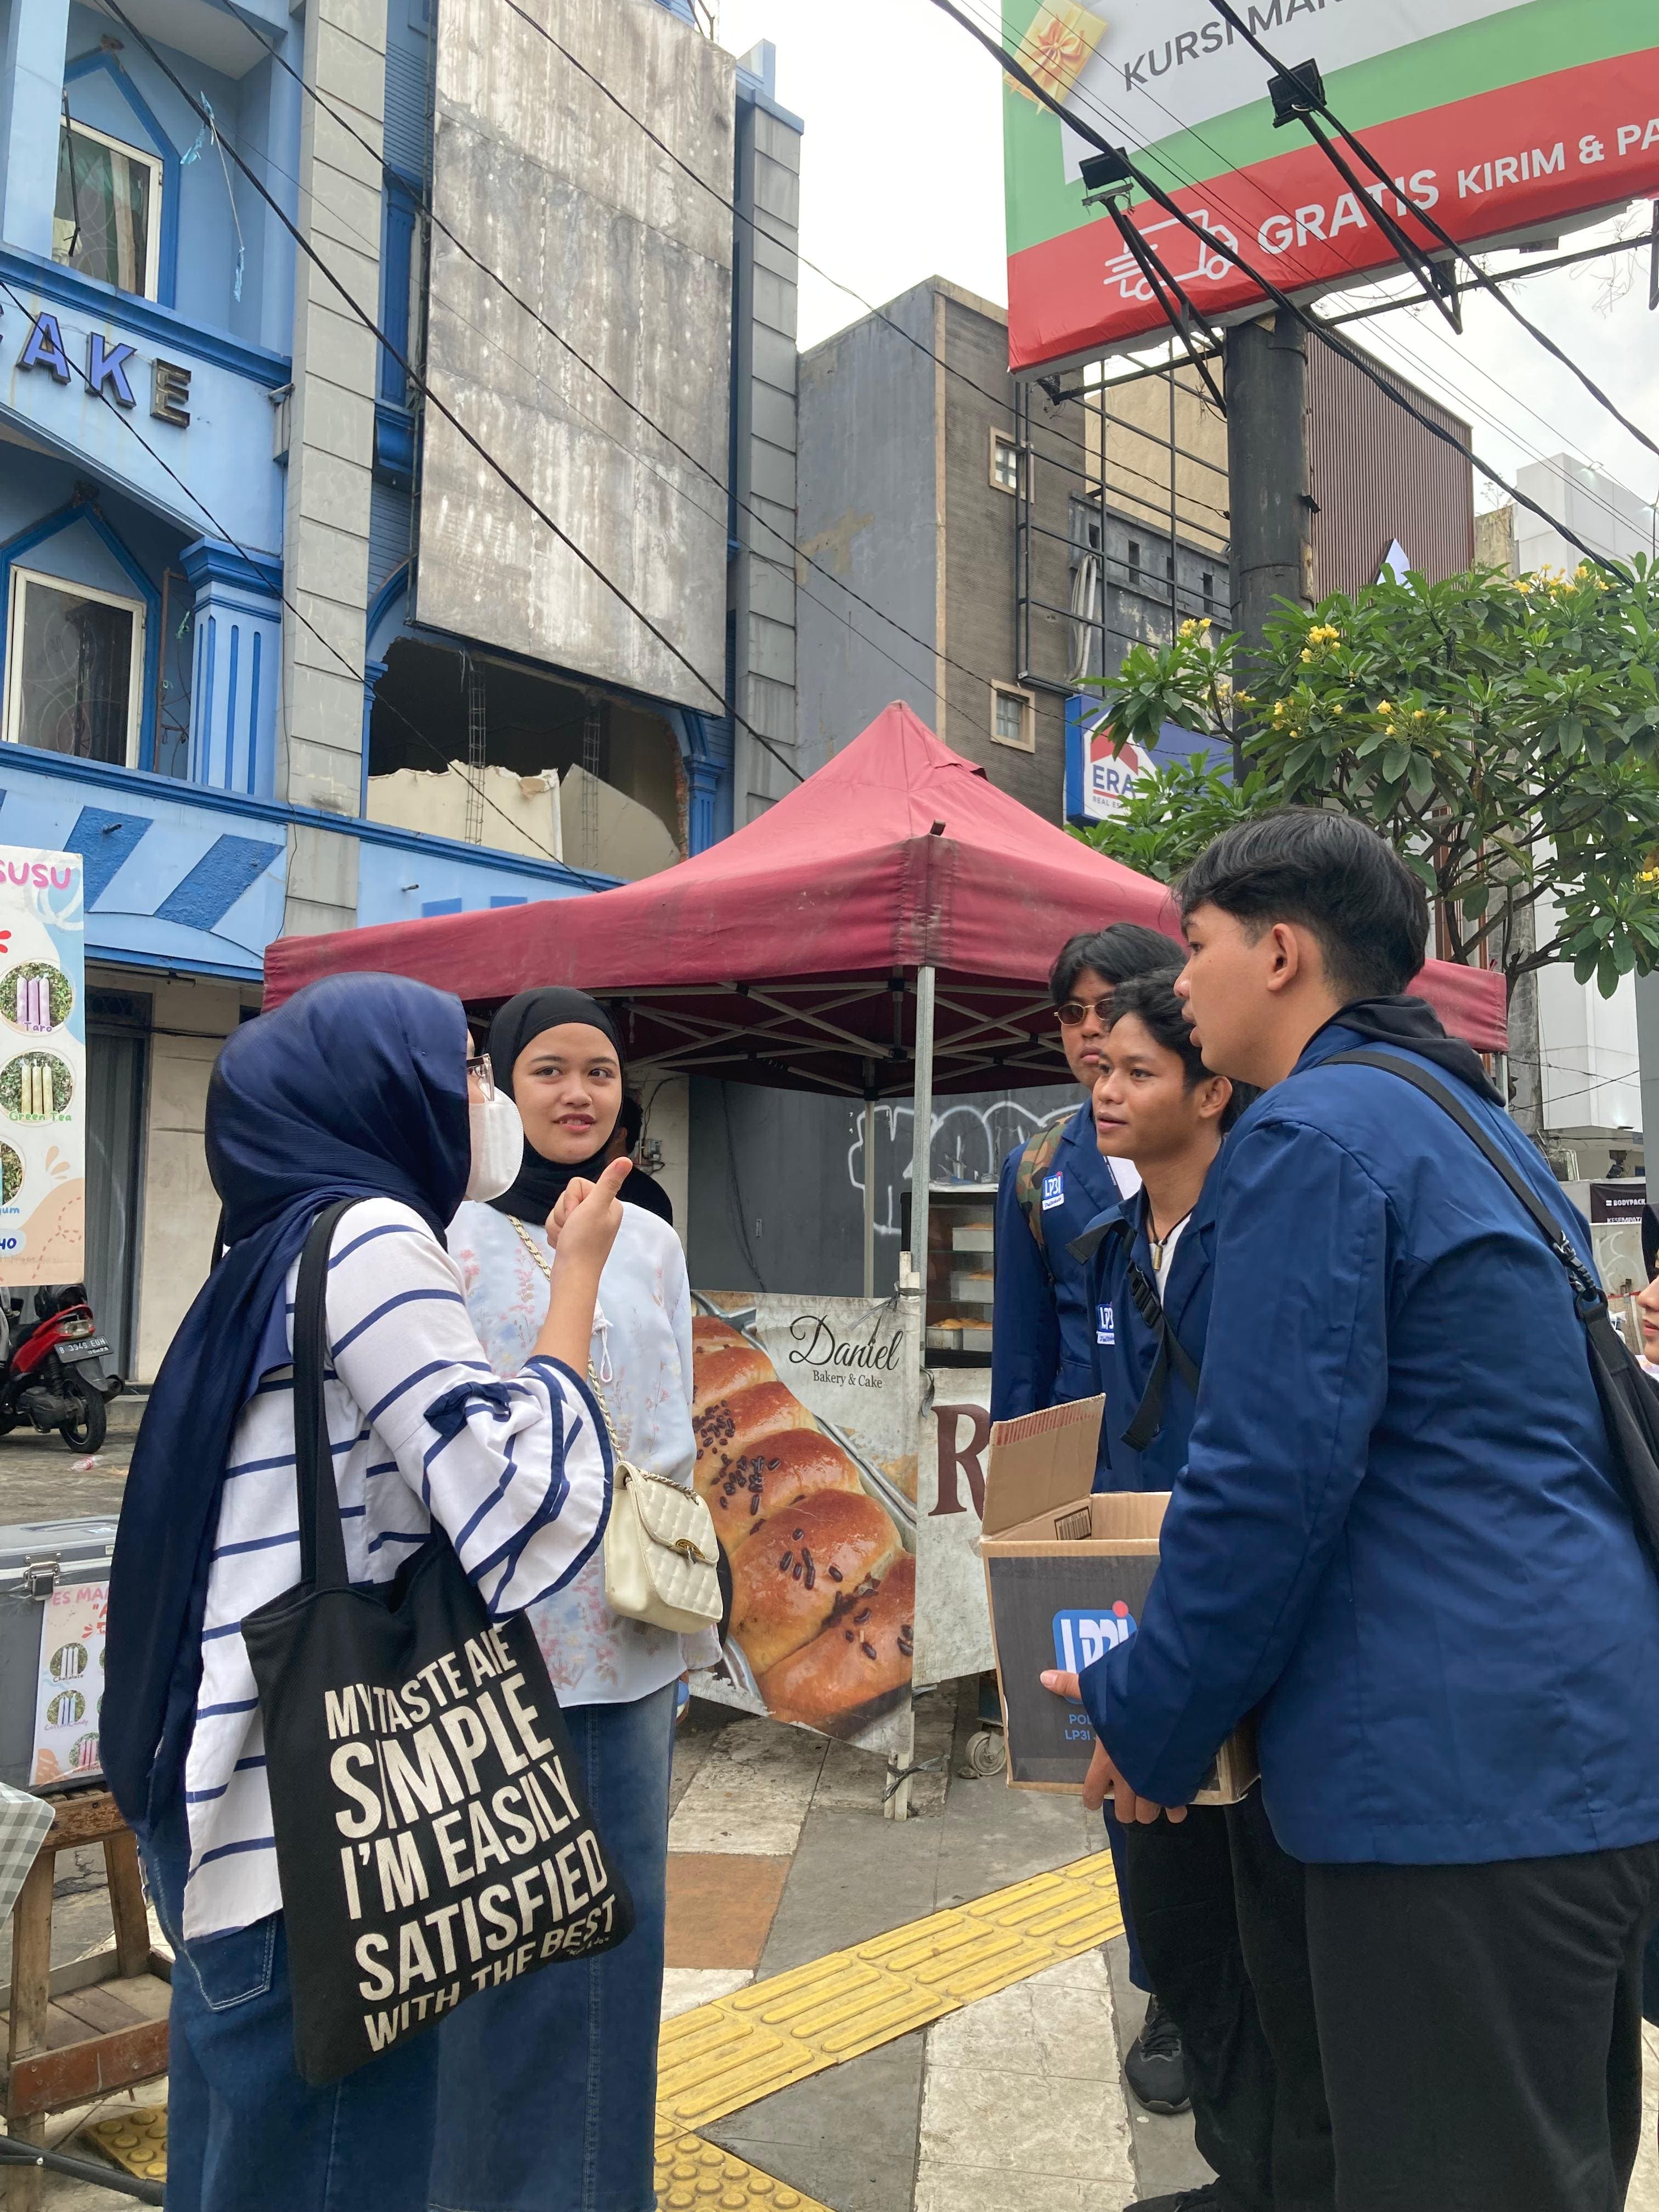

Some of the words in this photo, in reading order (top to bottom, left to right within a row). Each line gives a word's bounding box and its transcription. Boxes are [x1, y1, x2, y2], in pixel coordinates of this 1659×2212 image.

[1124, 18, 1234, 92] KURSI
[1248, 0, 1343, 36] MA
[1258, 170, 1439, 255] GRATIS
[1457, 143, 1565, 198] KIRIM
[1578, 135, 1605, 164] &
[0, 304, 192, 429] AKE
[1093, 765, 1136, 799] ERA
[1093, 796, 1110, 806] REAL
[24, 1022, 53, 1032] Taro
[9, 1111, 46, 1121] Green
[50, 1112, 72, 1121] Tea
[1613, 1198, 1646, 1206] BODYPACK
[1099, 1306, 1114, 1330] LP3
[789, 1314, 904, 1370] Daniel
[812, 1370, 847, 1387] Bakery
[848, 1373, 856, 1386] &
[858, 1374, 883, 1389] Cake
[53, 1592, 71, 1606] ES
[324, 1683, 375, 1740] MY
[373, 1651, 469, 1734] TASTE
[464, 1626, 517, 1688] AE
[329, 1673, 554, 1839] SIMPLE
[1065, 1729, 1091, 1741] LP3I
[340, 1832, 430, 1920] I'M
[432, 1755, 580, 1888] EASILY
[355, 1829, 609, 2001] SATISFIED
[364, 1988, 460, 2052] WITH
[471, 1942, 536, 1991] THE
[540, 1894, 616, 1959] BEST
